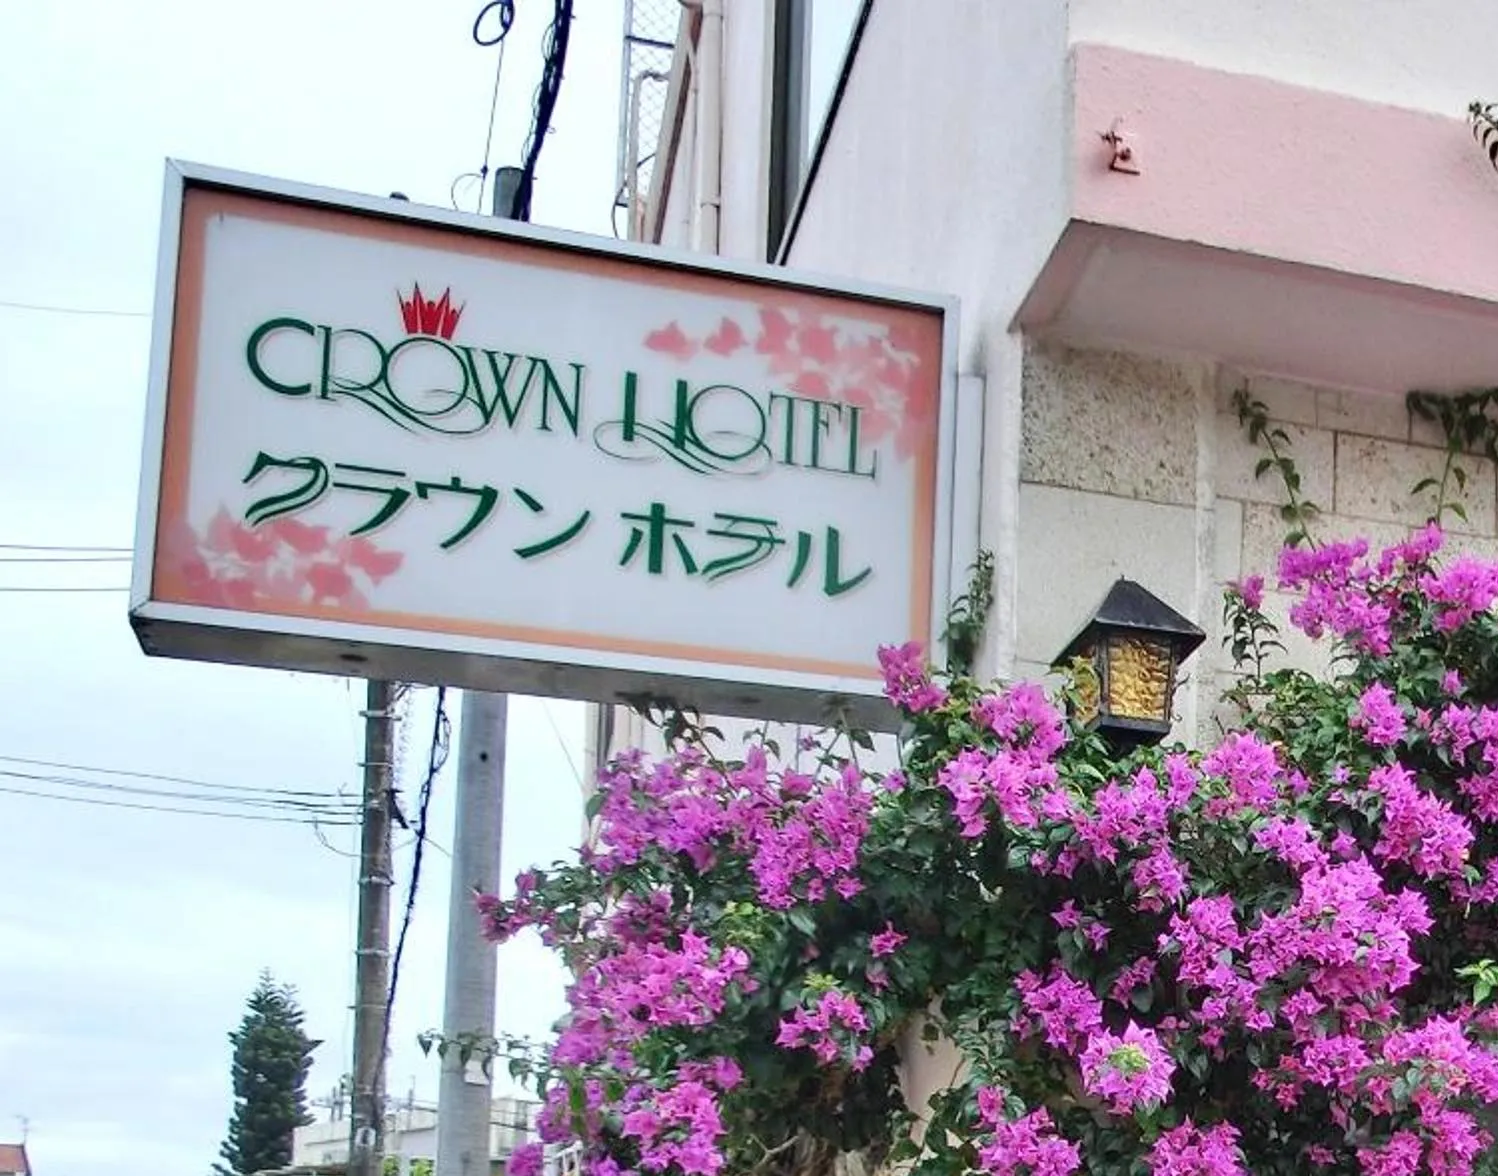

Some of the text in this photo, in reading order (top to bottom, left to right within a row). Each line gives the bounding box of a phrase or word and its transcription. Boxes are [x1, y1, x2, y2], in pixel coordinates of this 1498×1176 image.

[246, 317, 878, 480] CROWN HOTEL
[243, 451, 873, 597] クラウン ホテル
